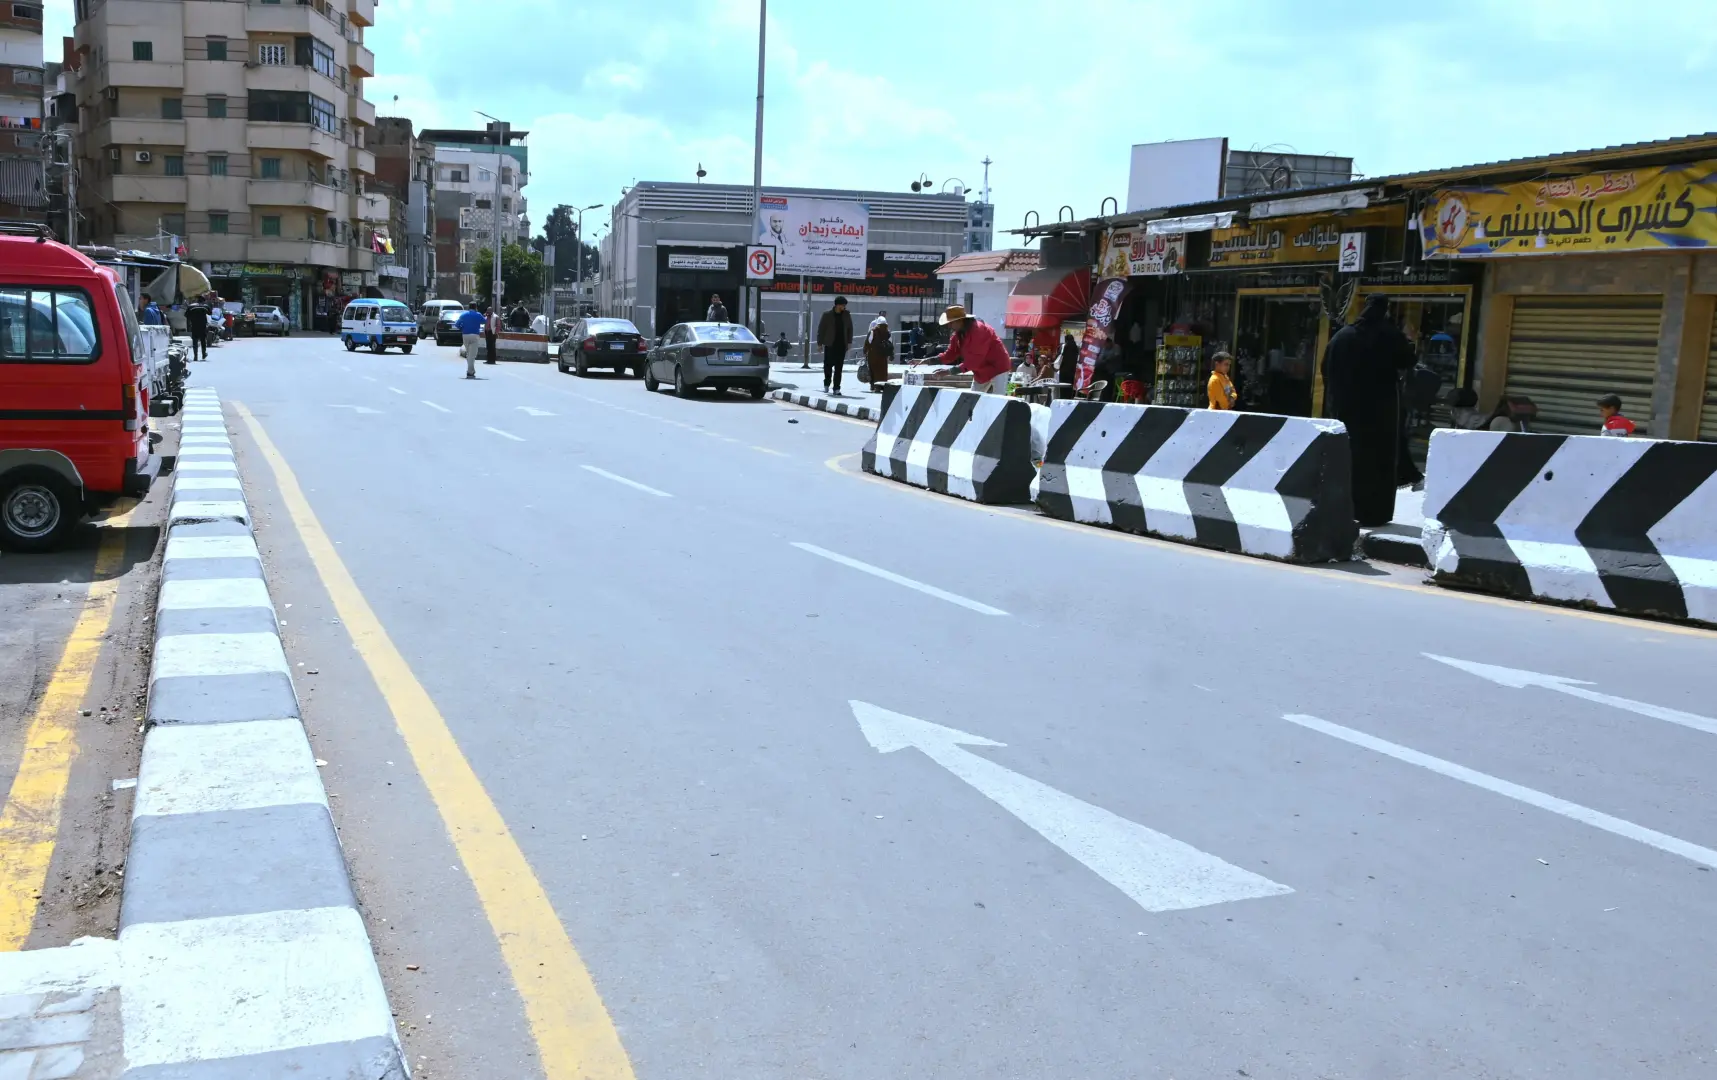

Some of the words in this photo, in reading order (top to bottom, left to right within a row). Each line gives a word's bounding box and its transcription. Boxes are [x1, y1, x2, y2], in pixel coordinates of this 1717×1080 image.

[1597, 184, 1695, 242] كشري
[799, 221, 829, 238] زيدان
[1484, 199, 1594, 248] الحسيني
[893, 267, 928, 279] محطة
[1132, 263, 1145, 274] BAB
[833, 282, 878, 296] Railway
